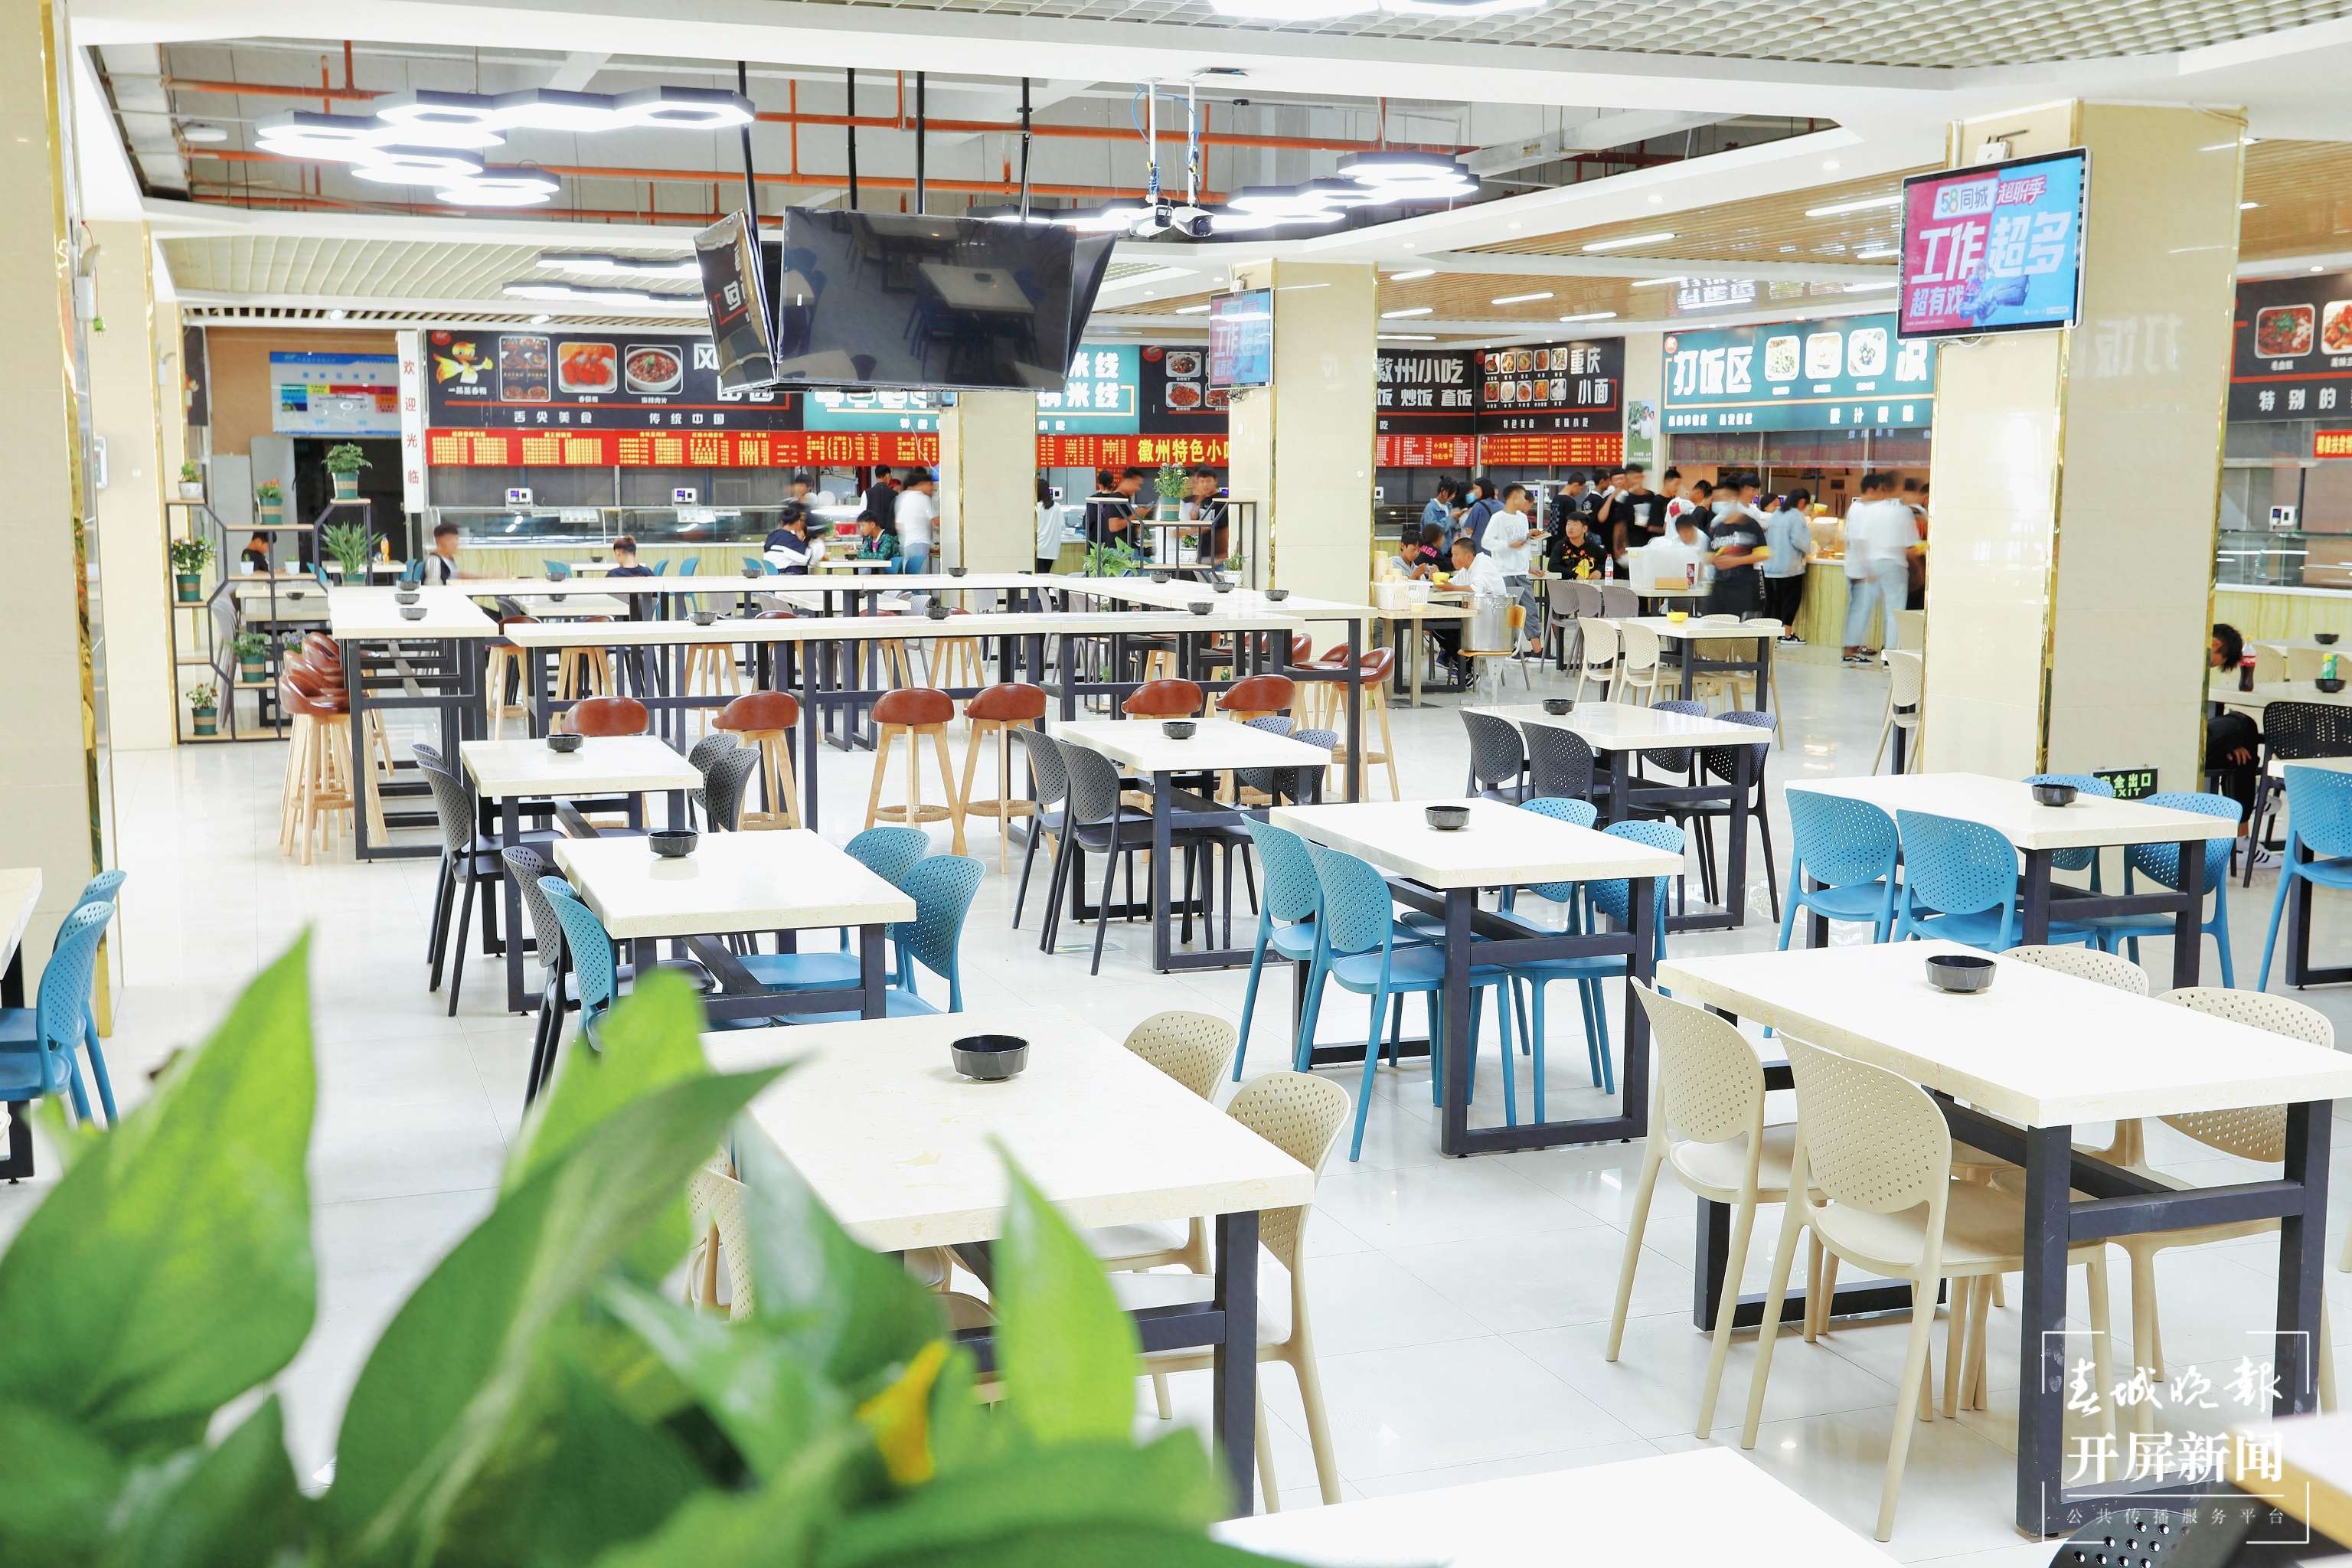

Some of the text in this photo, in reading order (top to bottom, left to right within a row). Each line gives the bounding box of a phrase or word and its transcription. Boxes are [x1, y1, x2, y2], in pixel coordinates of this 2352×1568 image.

[1941, 187, 1988, 213] 58同城
[1911, 211, 2072, 284] 工作超多
[1068, 351, 1119, 379] 米线
[1570, 347, 1601, 375] 重庆
[1673, 345, 1754, 397] 打饭区
[1400, 388, 1433, 407] 炒饭
[1441, 388, 1473, 407] 套饭
[1577, 378, 1609, 405] 小面
[2259, 387, 2352, 412] 特别的
[403, 359, 420, 485] 欢迎光临
[514, 410, 724, 426] 舌尖美食 传统中国
[1380, 420, 1389, 430] 吃
